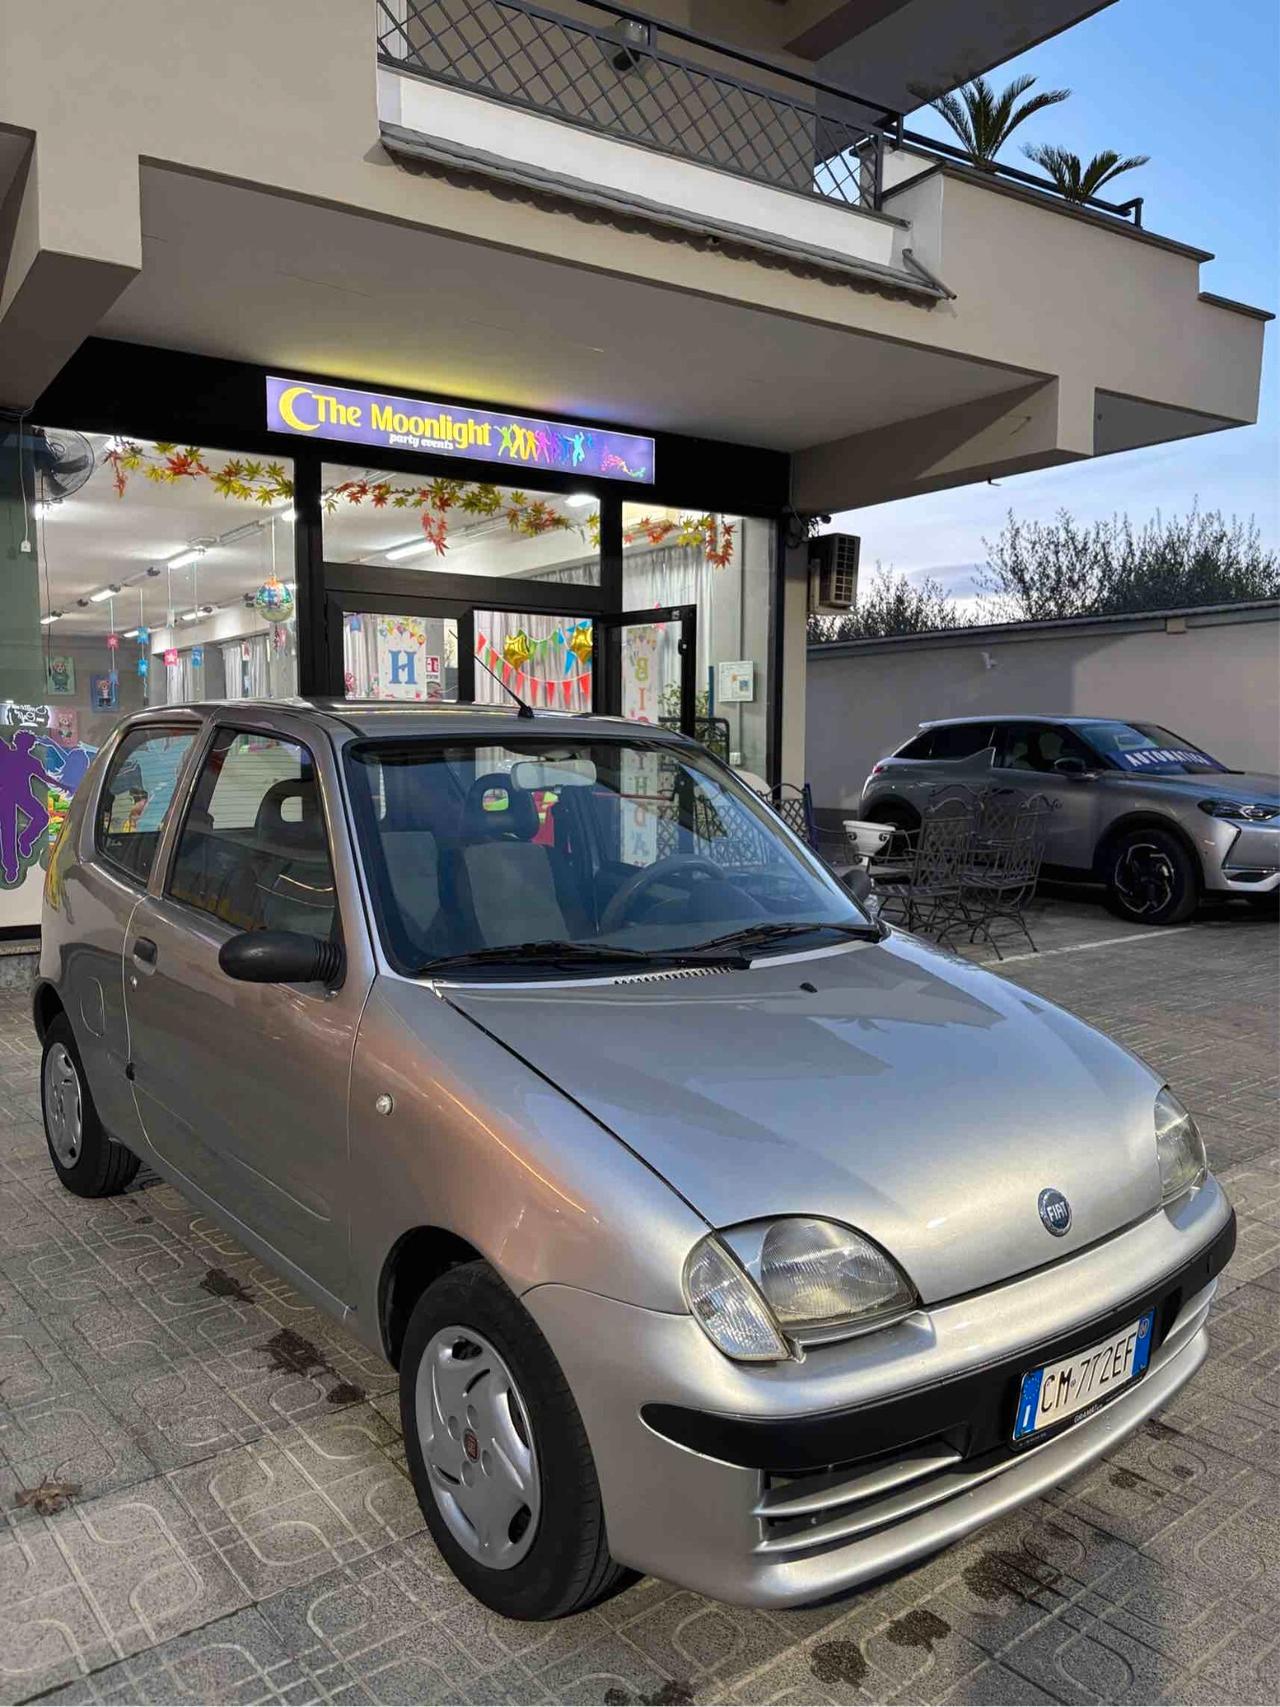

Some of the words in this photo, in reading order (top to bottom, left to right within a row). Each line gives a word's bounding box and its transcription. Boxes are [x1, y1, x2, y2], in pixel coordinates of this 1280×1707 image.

[312, 394, 361, 427] The
[371, 403, 492, 449] Moonlight
[389, 433, 420, 448] party
[421, 439, 453, 450] events
[1047, 1201, 1068, 1222] FIAT
